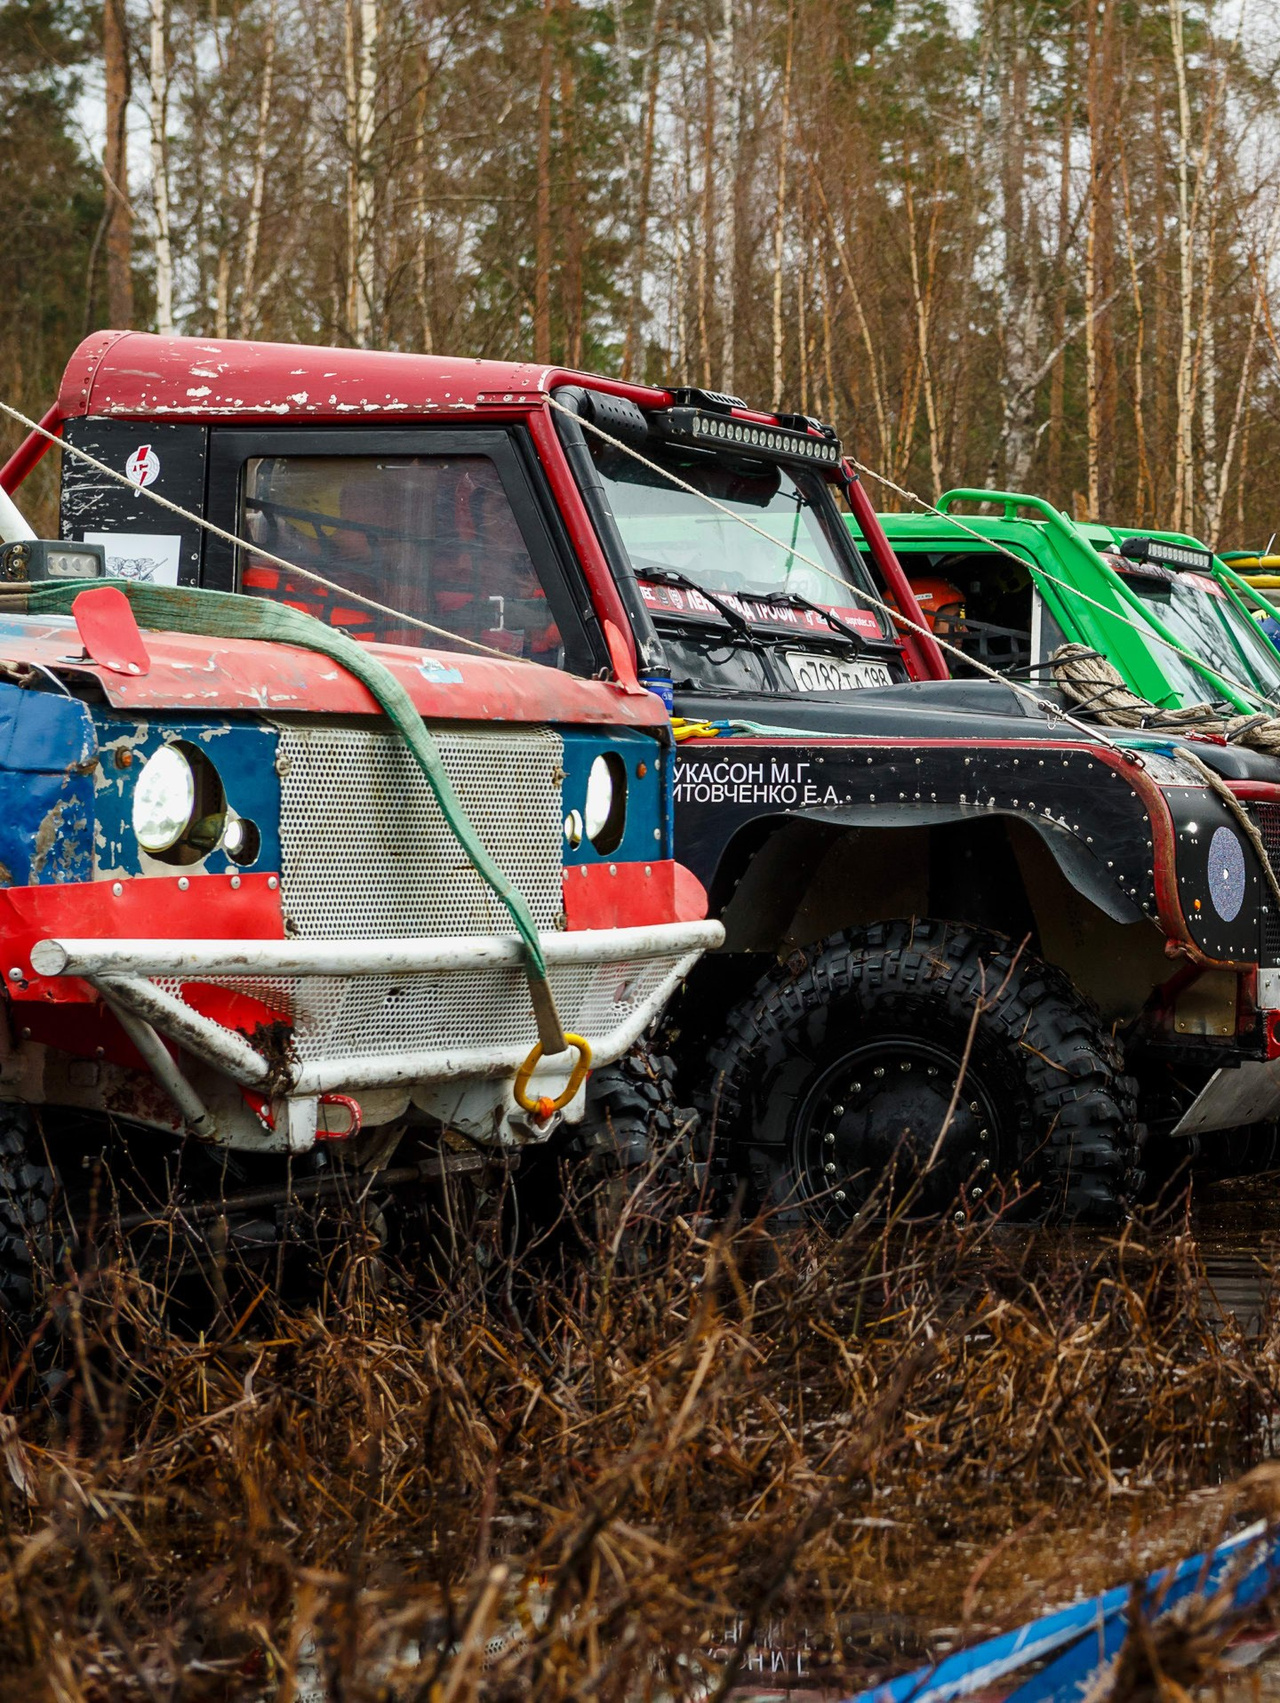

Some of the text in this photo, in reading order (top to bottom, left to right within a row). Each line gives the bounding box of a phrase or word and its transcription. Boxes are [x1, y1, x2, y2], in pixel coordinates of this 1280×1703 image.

[673, 763, 812, 783] УКАСОН М.Г.
[672, 784, 843, 804] ИТОВЧЕНКО Е.А.
